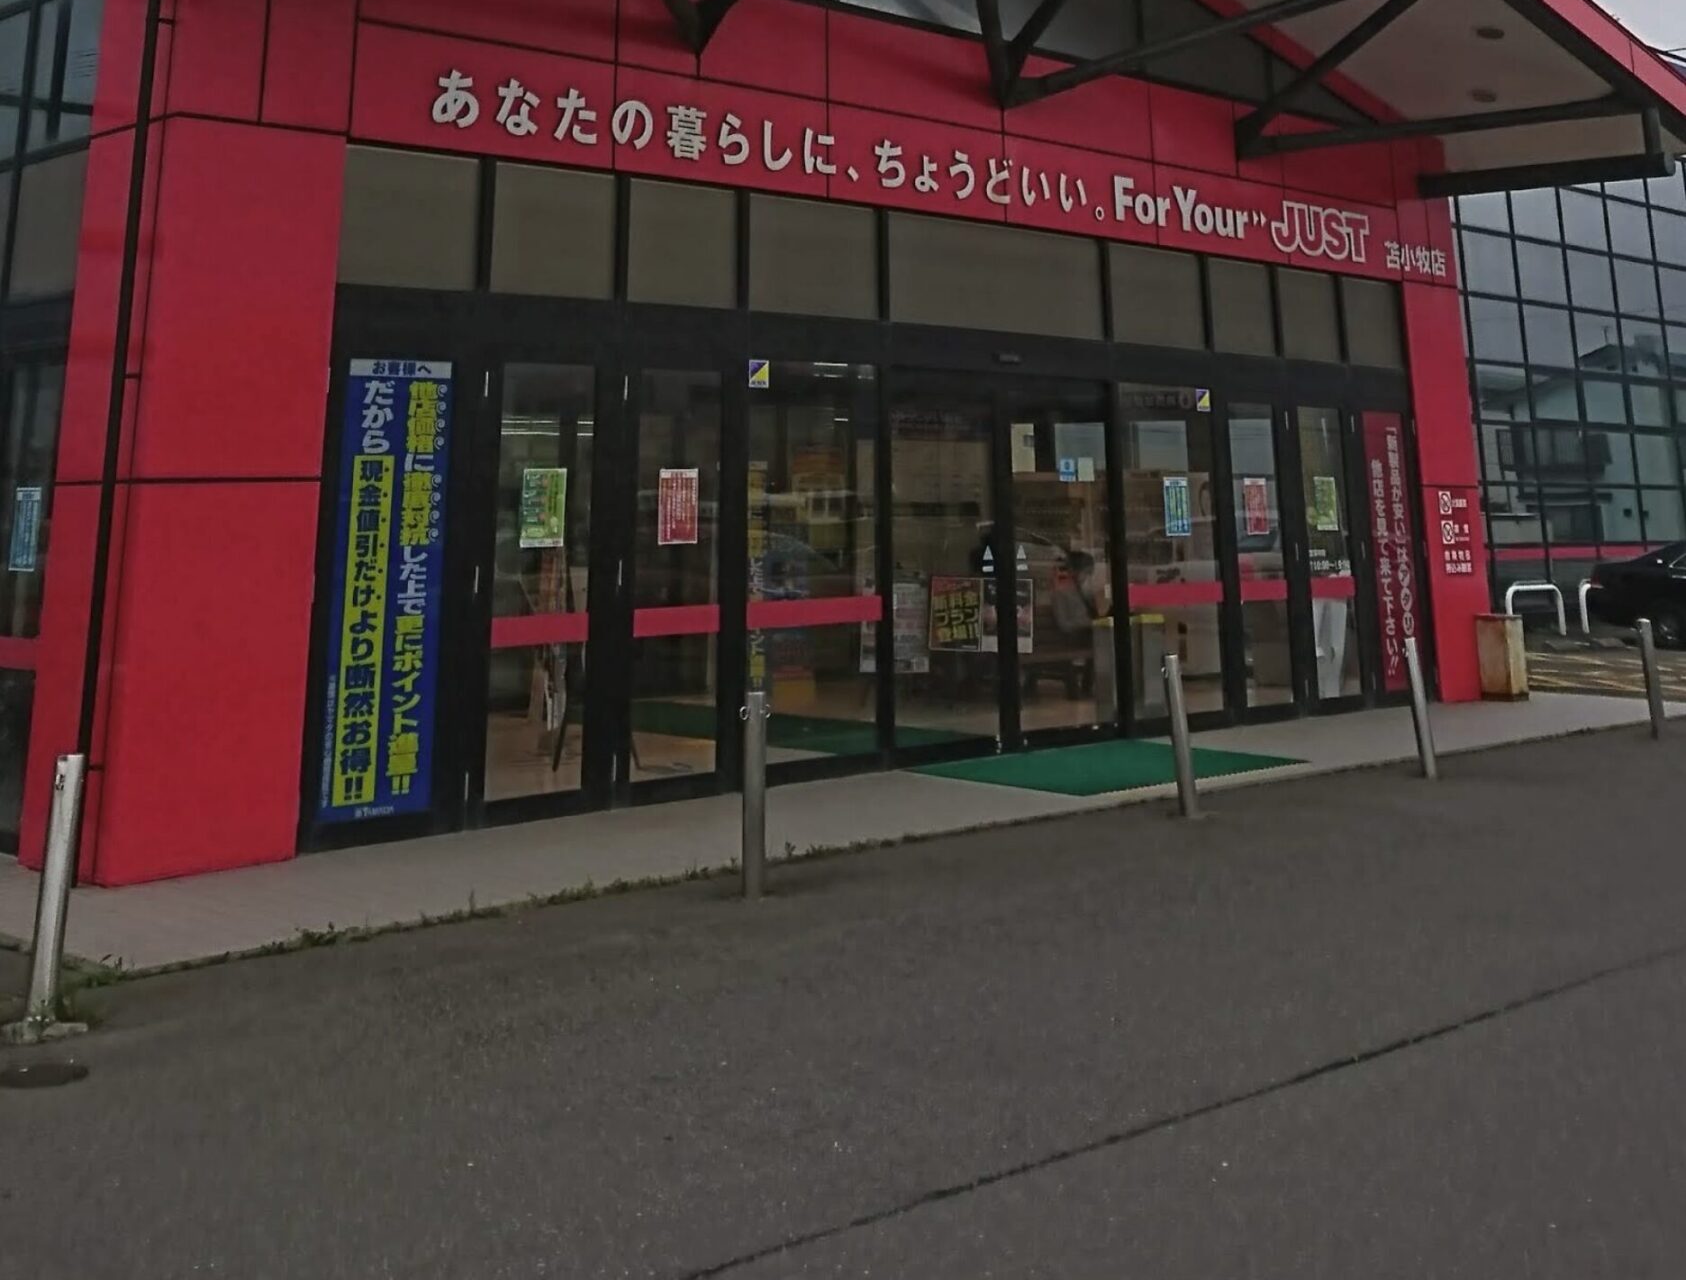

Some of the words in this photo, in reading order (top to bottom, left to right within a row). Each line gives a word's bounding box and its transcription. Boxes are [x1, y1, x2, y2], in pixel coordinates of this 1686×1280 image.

[1270, 200, 1370, 263] JUST
[1384, 240, 1447, 277] 苫小牧店
